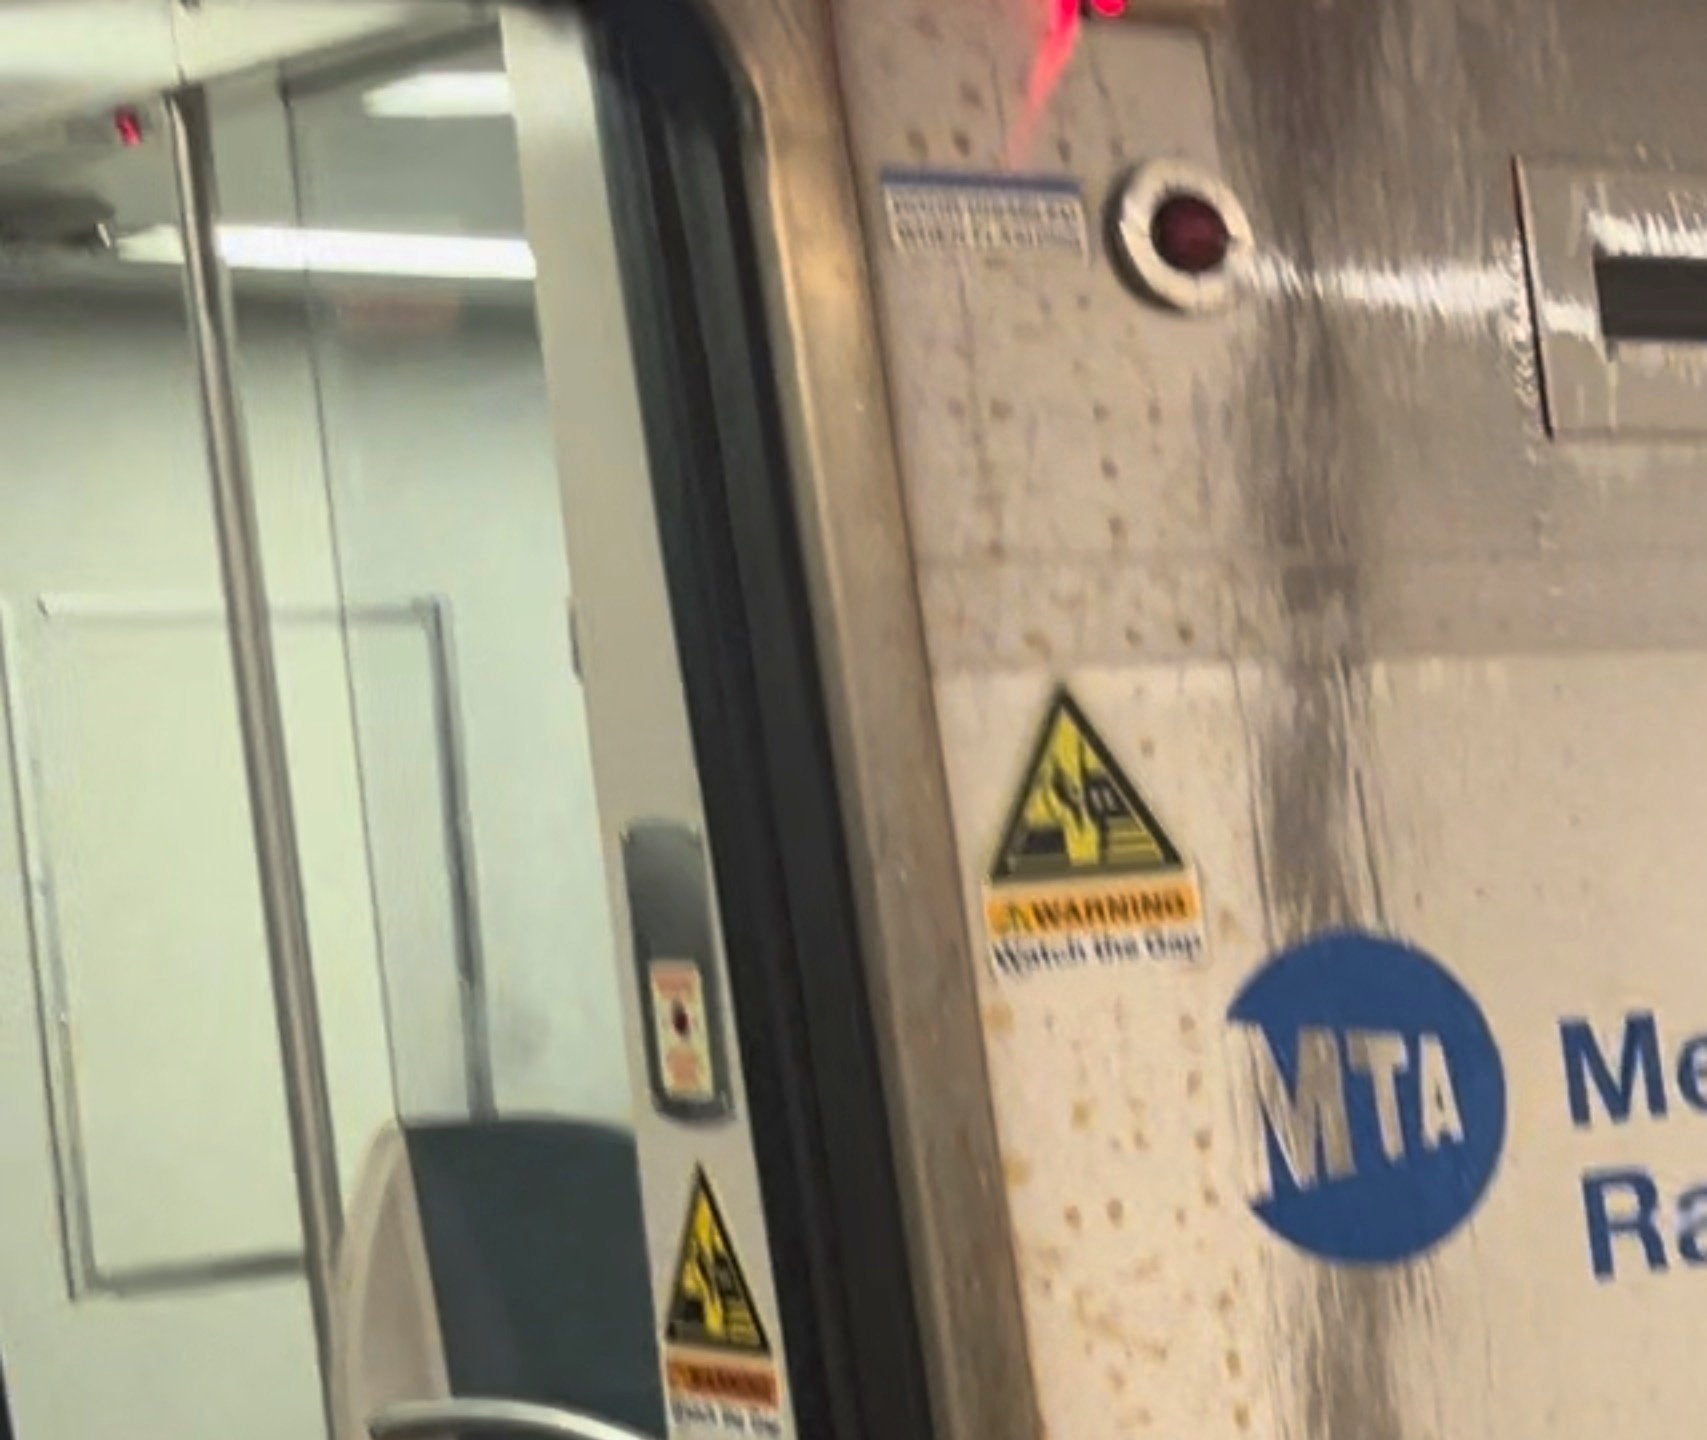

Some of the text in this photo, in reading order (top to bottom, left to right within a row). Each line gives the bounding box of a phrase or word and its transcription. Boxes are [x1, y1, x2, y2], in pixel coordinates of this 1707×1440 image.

[1031, 891, 1188, 933] WARNING
[991, 936, 1088, 976] Watch
[1093, 932, 1140, 964] the
[1228, 1022, 1465, 1200] MTA
